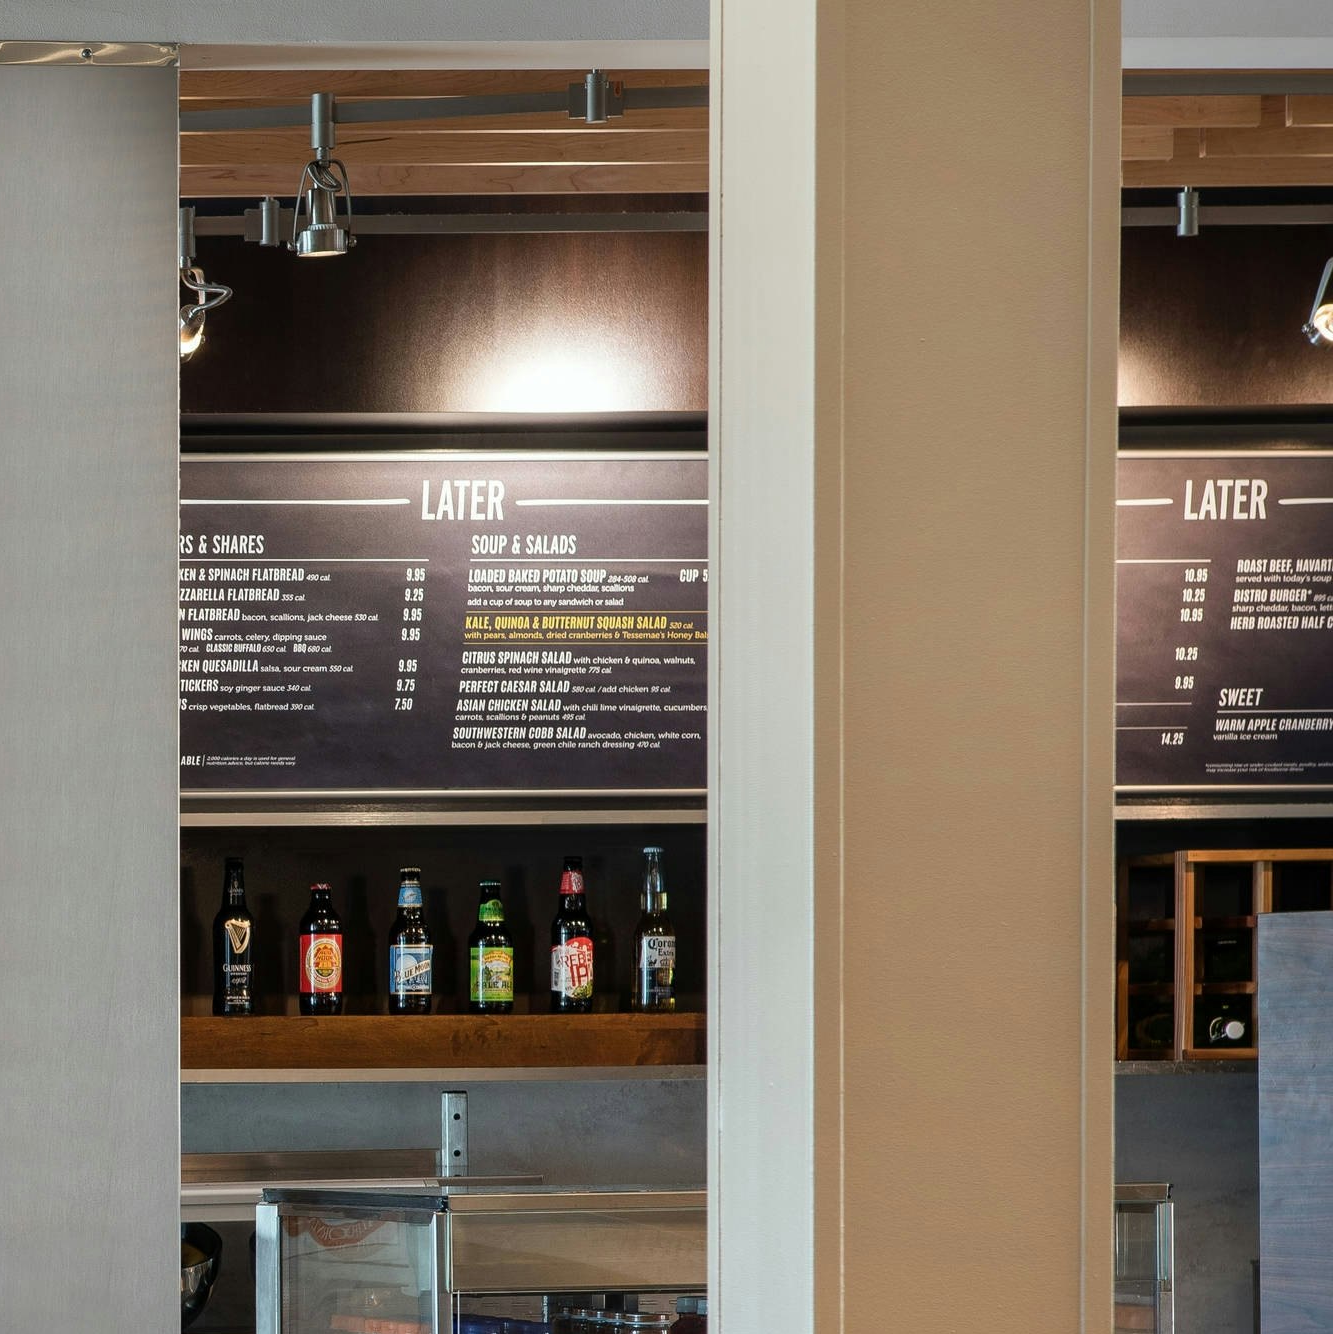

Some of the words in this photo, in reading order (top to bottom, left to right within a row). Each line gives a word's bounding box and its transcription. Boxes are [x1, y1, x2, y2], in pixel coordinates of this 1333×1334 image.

[422, 479, 505, 520] LATER
[1184, 480, 1267, 520] LATER
[199, 535, 207, 553] &
[213, 535, 264, 553] SHARES
[472, 535, 507, 554] SOUP
[512, 535, 520, 554] &
[526, 535, 576, 554] SALADS
[1237, 559, 1267, 572] ROAST
[1270, 559, 1293, 573] BEEF,
[1185, 568, 1207, 582] 10.95
[1234, 589, 1267, 602] BISTRO
[188, 609, 240, 620] FLATBREAD
[403, 608, 422, 621] 9.95
[466, 616, 491, 630] KALE,
[495, 617, 529, 630] QUINOA
[532, 617, 539, 629] &
[542, 616, 595, 629] BUTTERNUT
[597, 617, 634, 630] SQUASH
[637, 616, 666, 629] SALAD
[460, 681, 499, 692] PERFECT
[501, 681, 537, 692] CAESAR
[540, 681, 570, 692] SALAD
[1219, 689, 1263, 706] SWEET
[1216, 719, 1245, 731] WARM
[1248, 719, 1277, 730] APPLE
[223, 963, 251, 972] GUINNESS
